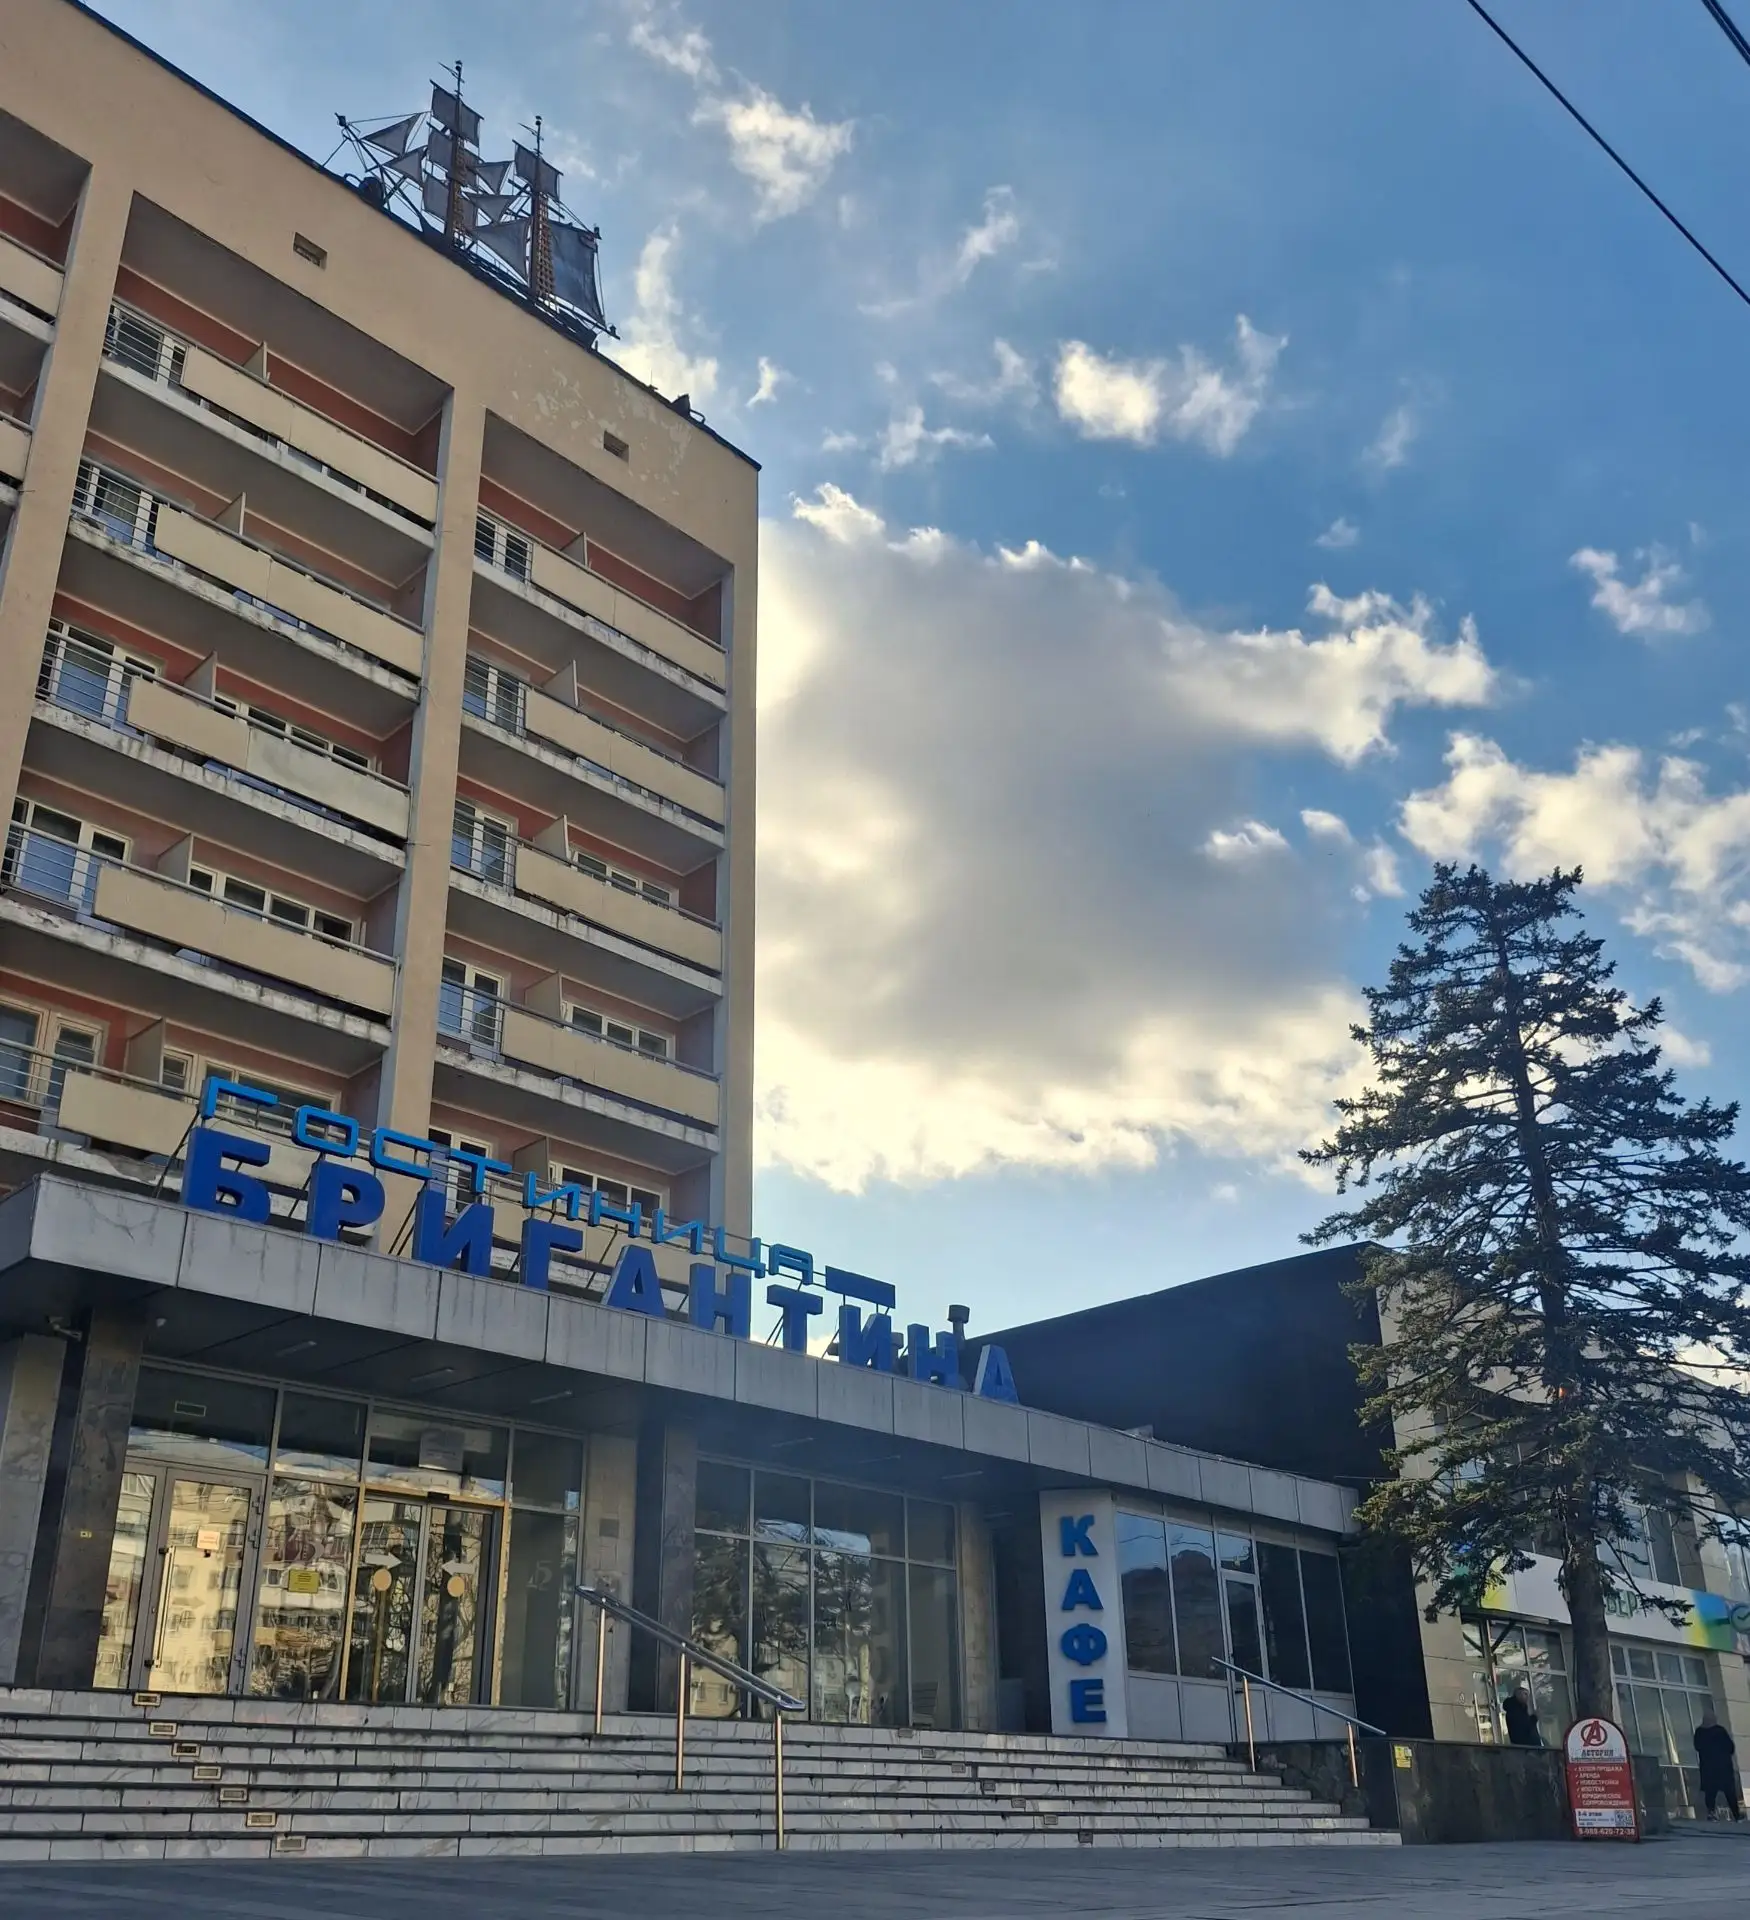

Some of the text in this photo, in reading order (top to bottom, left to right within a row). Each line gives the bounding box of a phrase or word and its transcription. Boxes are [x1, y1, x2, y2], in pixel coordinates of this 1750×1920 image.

[181, 1126, 1020, 1405] БРИГАНТИНА
[201, 1076, 813, 1285] ГОСТИНИЦА
[1060, 1514, 1108, 1723] КАФЕ
